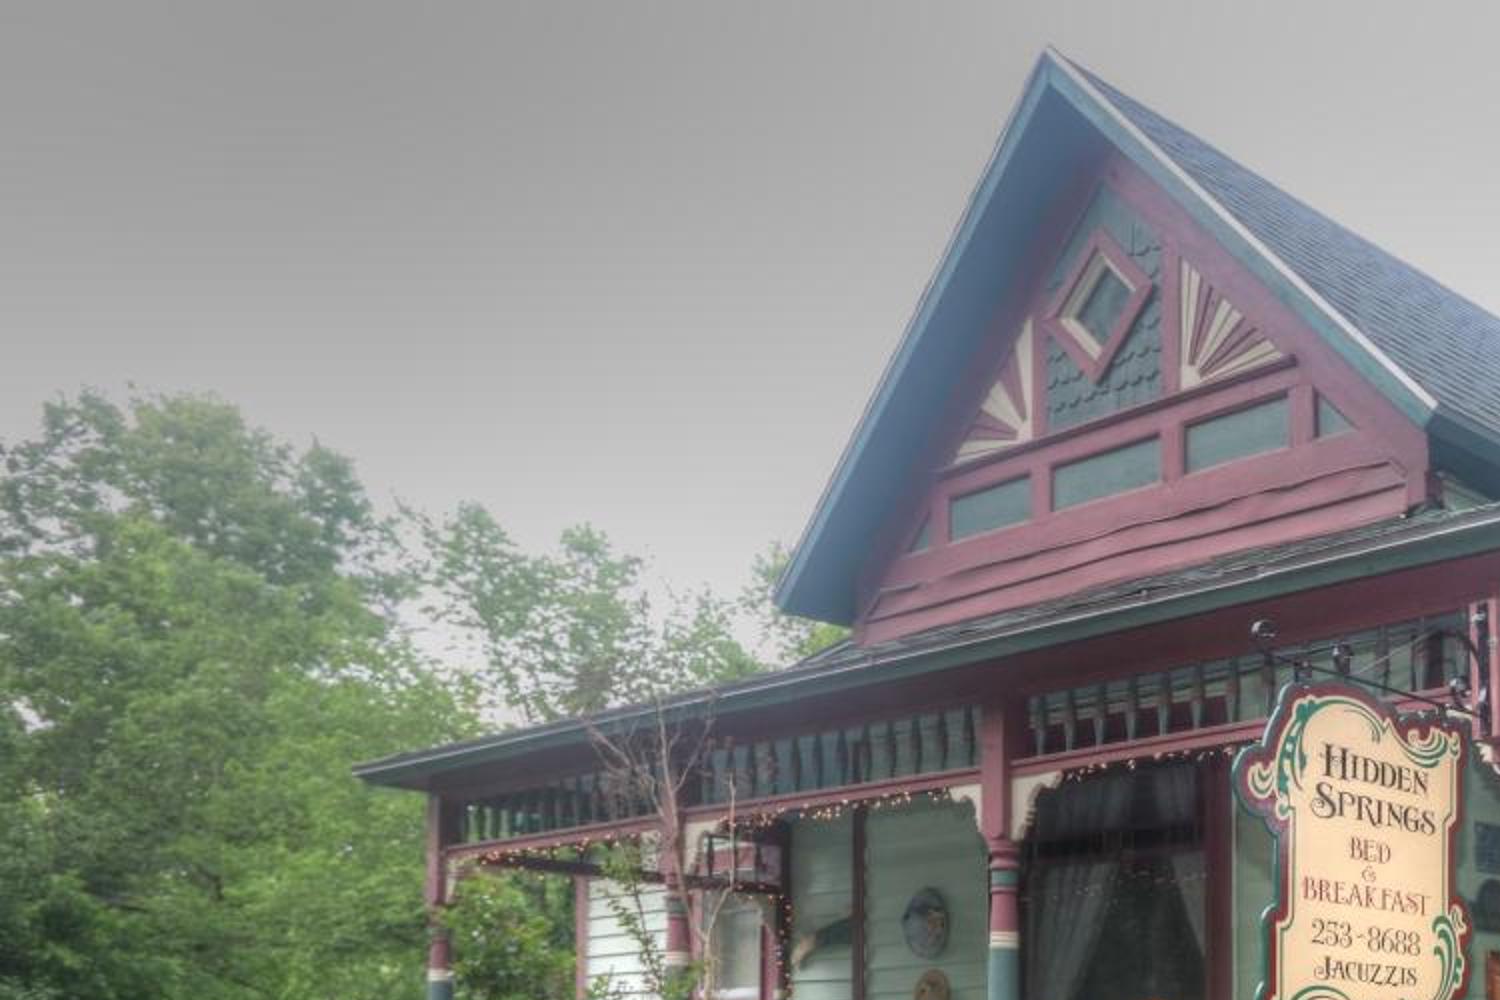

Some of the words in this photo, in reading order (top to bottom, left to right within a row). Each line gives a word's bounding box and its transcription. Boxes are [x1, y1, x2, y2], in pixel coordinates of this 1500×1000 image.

[1318, 743, 1429, 796] HIDDEN
[1310, 781, 1437, 836] SPRINGS
[1349, 836, 1392, 865] BED
[1302, 876, 1433, 916] BREAKFAST
[1313, 956, 1418, 987] JACUZZIS
